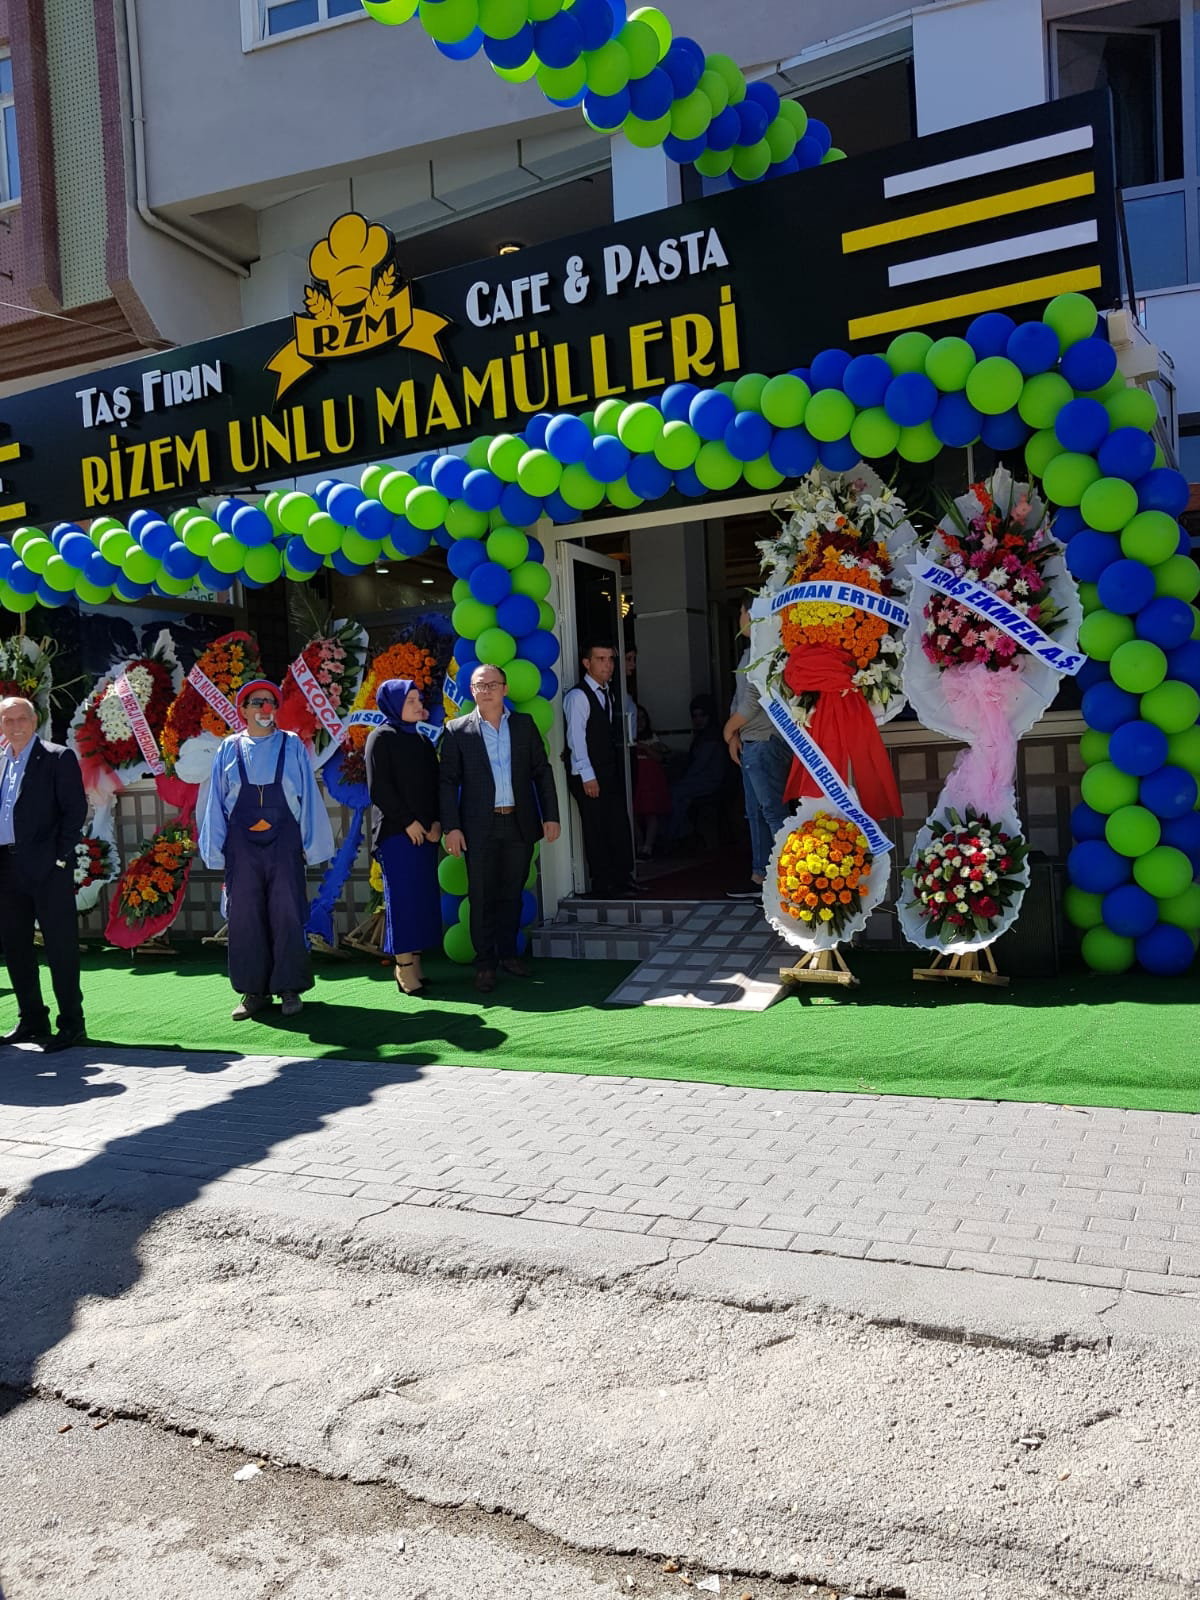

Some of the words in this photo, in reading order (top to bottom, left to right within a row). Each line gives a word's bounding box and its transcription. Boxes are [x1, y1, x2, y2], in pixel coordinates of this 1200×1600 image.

[465, 272, 551, 328] CAFE
[563, 255, 590, 304] &
[603, 227, 729, 296] PASTA
[312, 307, 397, 355] RZM
[75, 387, 132, 429] TAŞ
[141, 360, 223, 412] FIRIN
[81, 428, 211, 508] RİZEM
[228, 395, 354, 473] UNLU
[376, 285, 741, 445] MAMÜLLERİ
[771, 585, 833, 610] LOKMAN
[922, 567, 973, 596] YEPAŞ
[965, 590, 1047, 647] EKMEK
